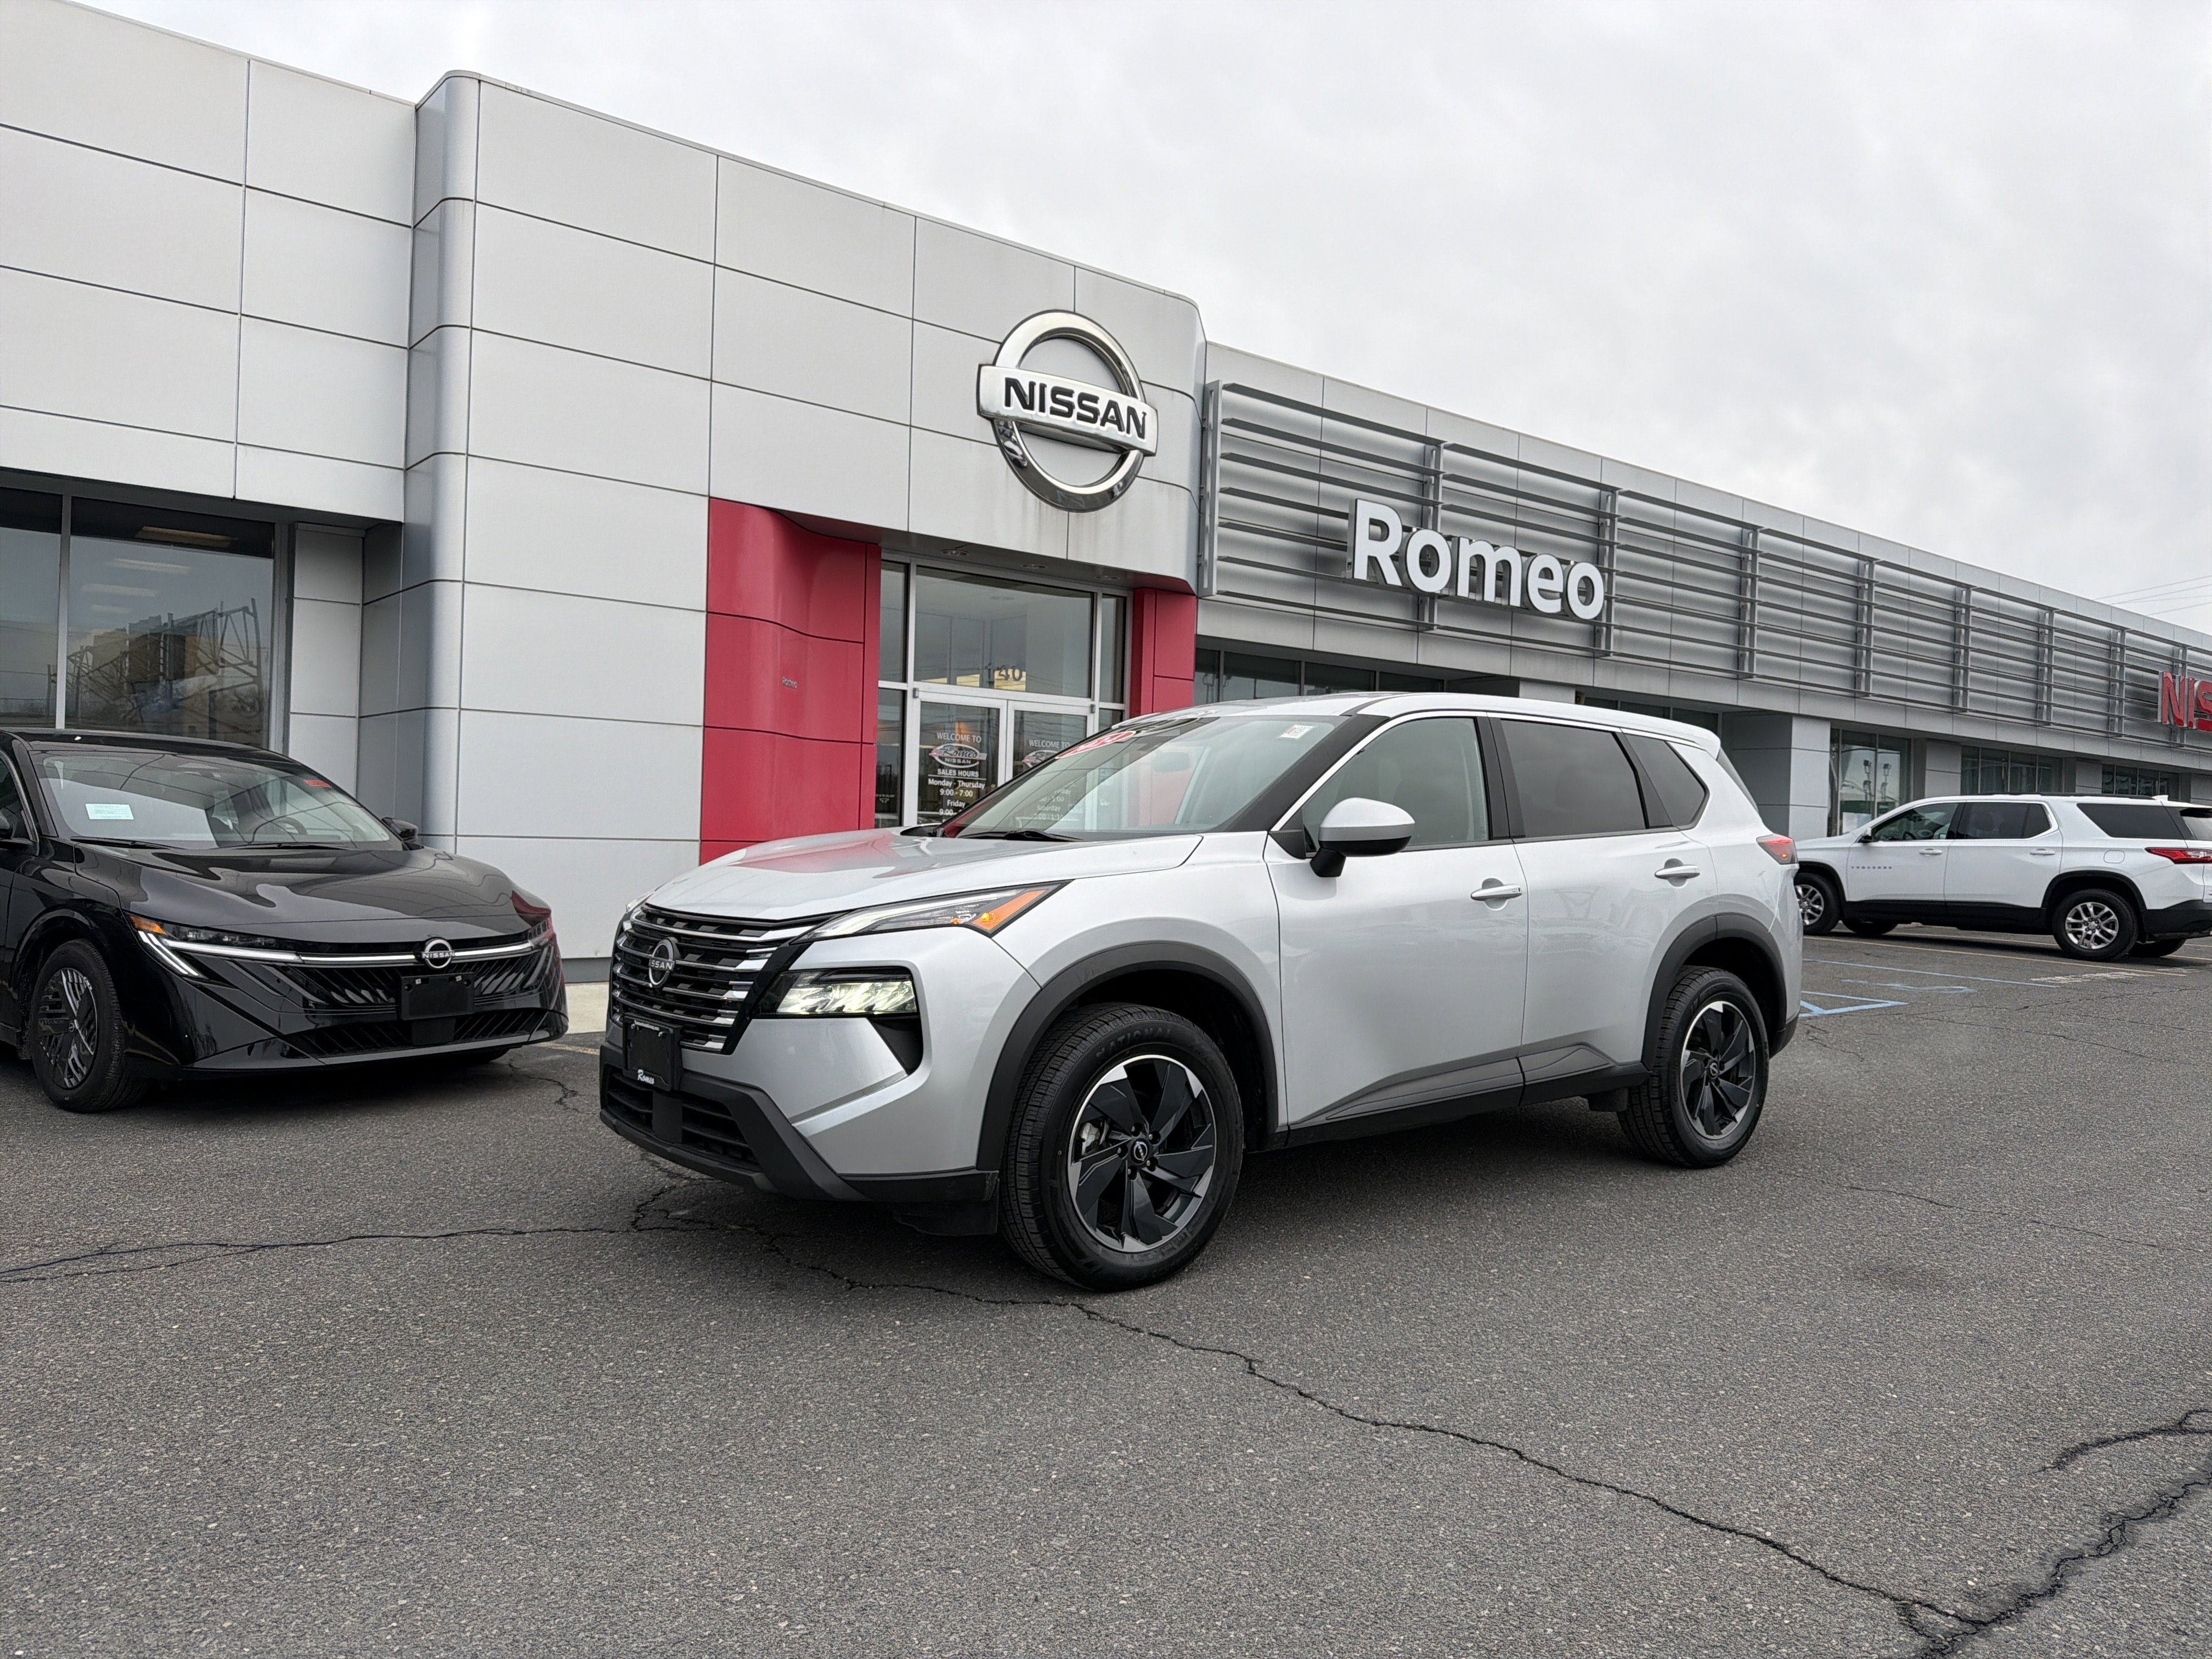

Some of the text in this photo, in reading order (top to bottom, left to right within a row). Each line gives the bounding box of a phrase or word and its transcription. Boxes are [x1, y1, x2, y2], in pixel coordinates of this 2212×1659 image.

[1005, 377, 1147, 440] NISSAN
[1351, 498, 1604, 620] Romeo
[985, 663, 1023, 682] 140
[937, 732, 982, 743] WELCOME TO
[1029, 740, 1059, 748] WELCOME
[942, 744, 978, 758] Romeo
[928, 778, 952, 787] Monday
[957, 780, 985, 789] Thursday
[947, 799, 966, 808] Friday
[637, 1069, 654, 1085] Romeo
